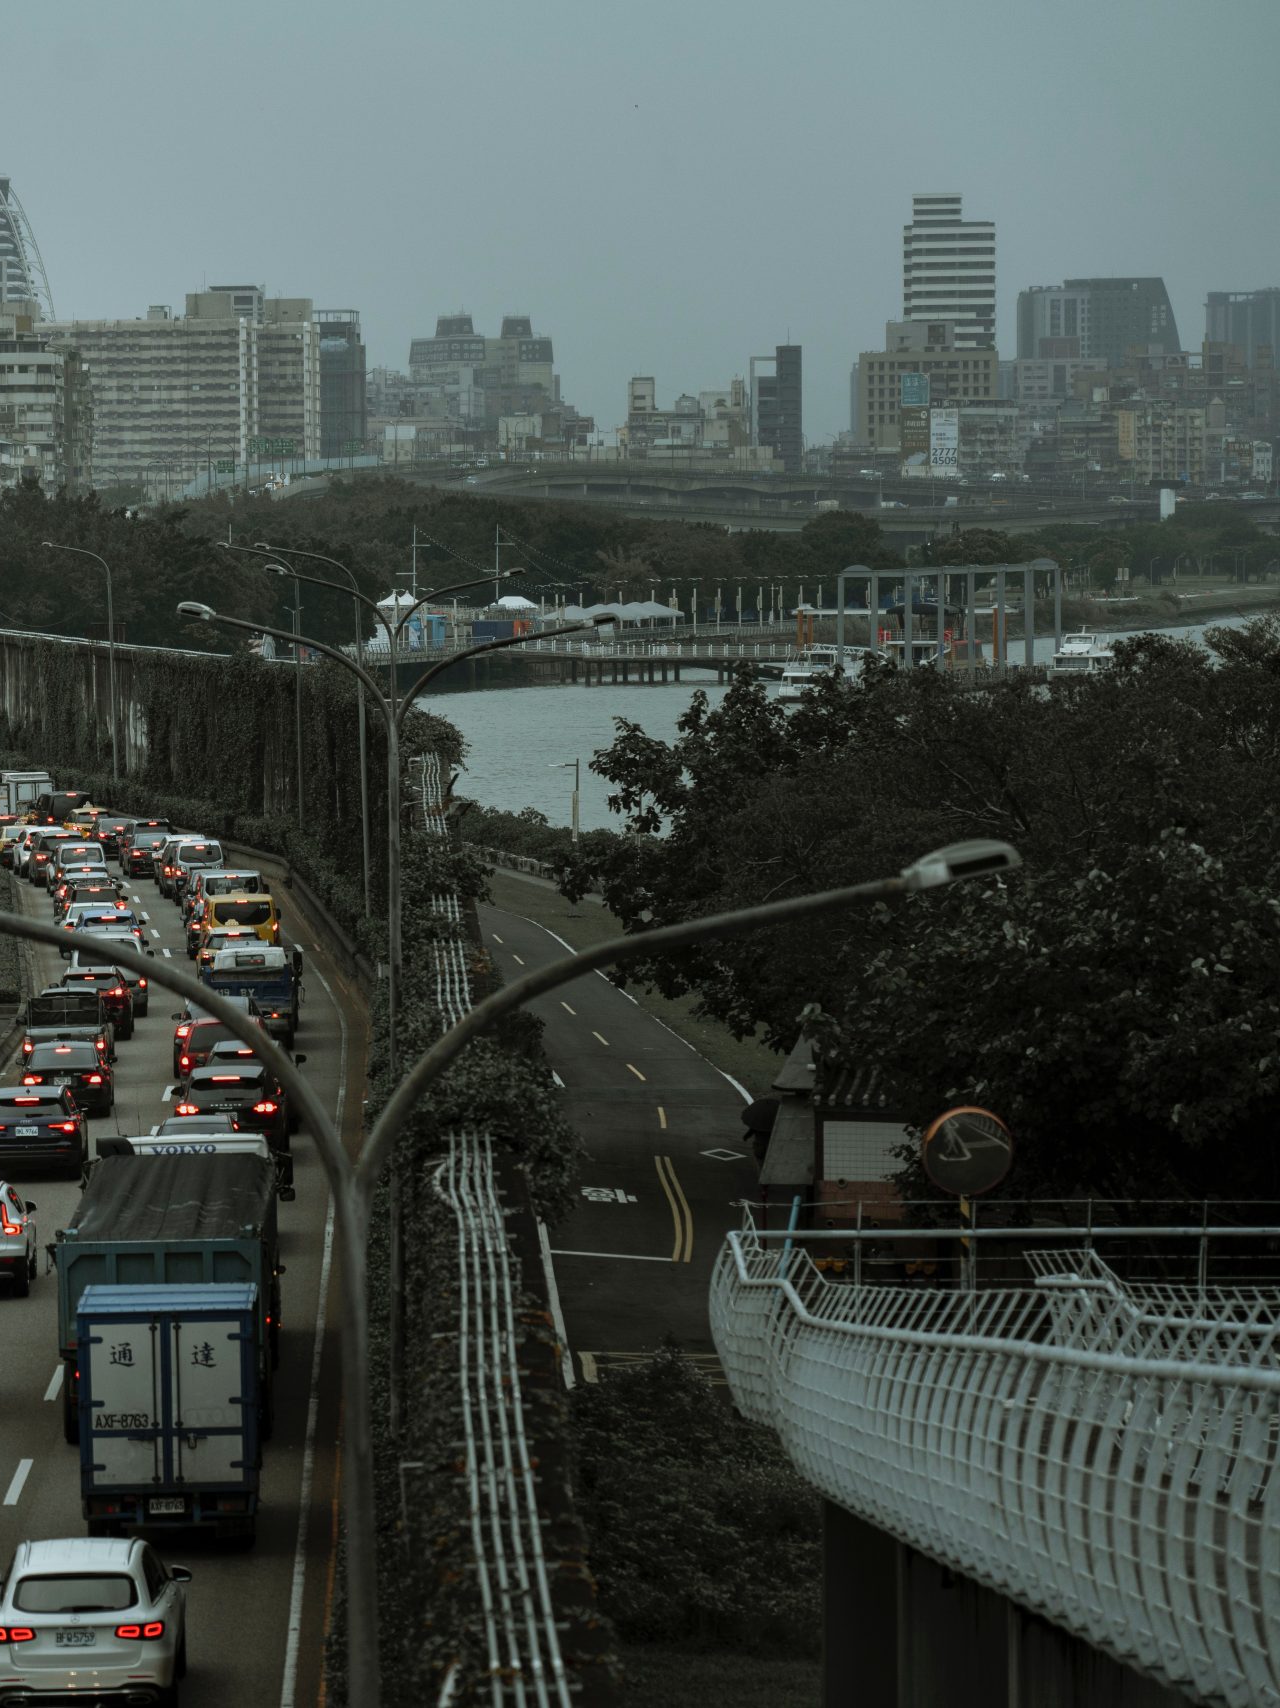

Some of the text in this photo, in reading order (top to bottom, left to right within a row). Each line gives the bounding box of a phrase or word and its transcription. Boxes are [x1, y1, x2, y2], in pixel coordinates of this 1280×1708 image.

[932, 447, 957, 456] 2777
[932, 456, 957, 465] 4509
[151, 1144, 216, 1157] VOLVO
[109, 1341, 217, 1368] 通 達
[95, 1414, 150, 1429] AXF-8763
